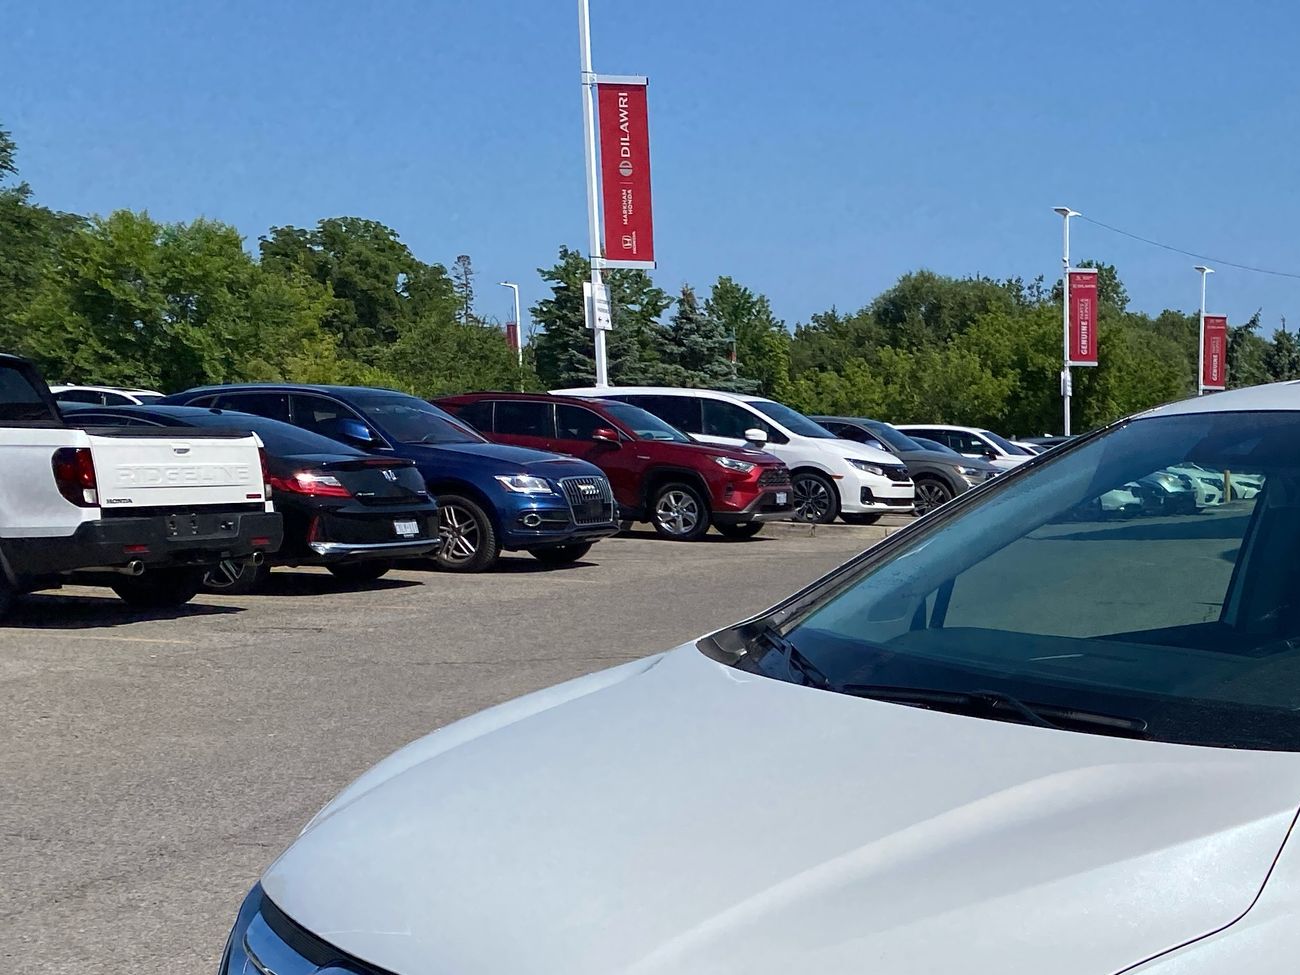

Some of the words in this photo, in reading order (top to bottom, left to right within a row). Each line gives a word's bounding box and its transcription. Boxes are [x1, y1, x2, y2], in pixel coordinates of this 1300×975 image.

[618, 92, 631, 158] DILAWRI
[1080, 320, 1088, 355] GENUINE
[115, 466, 250, 485] RIDGELINE
